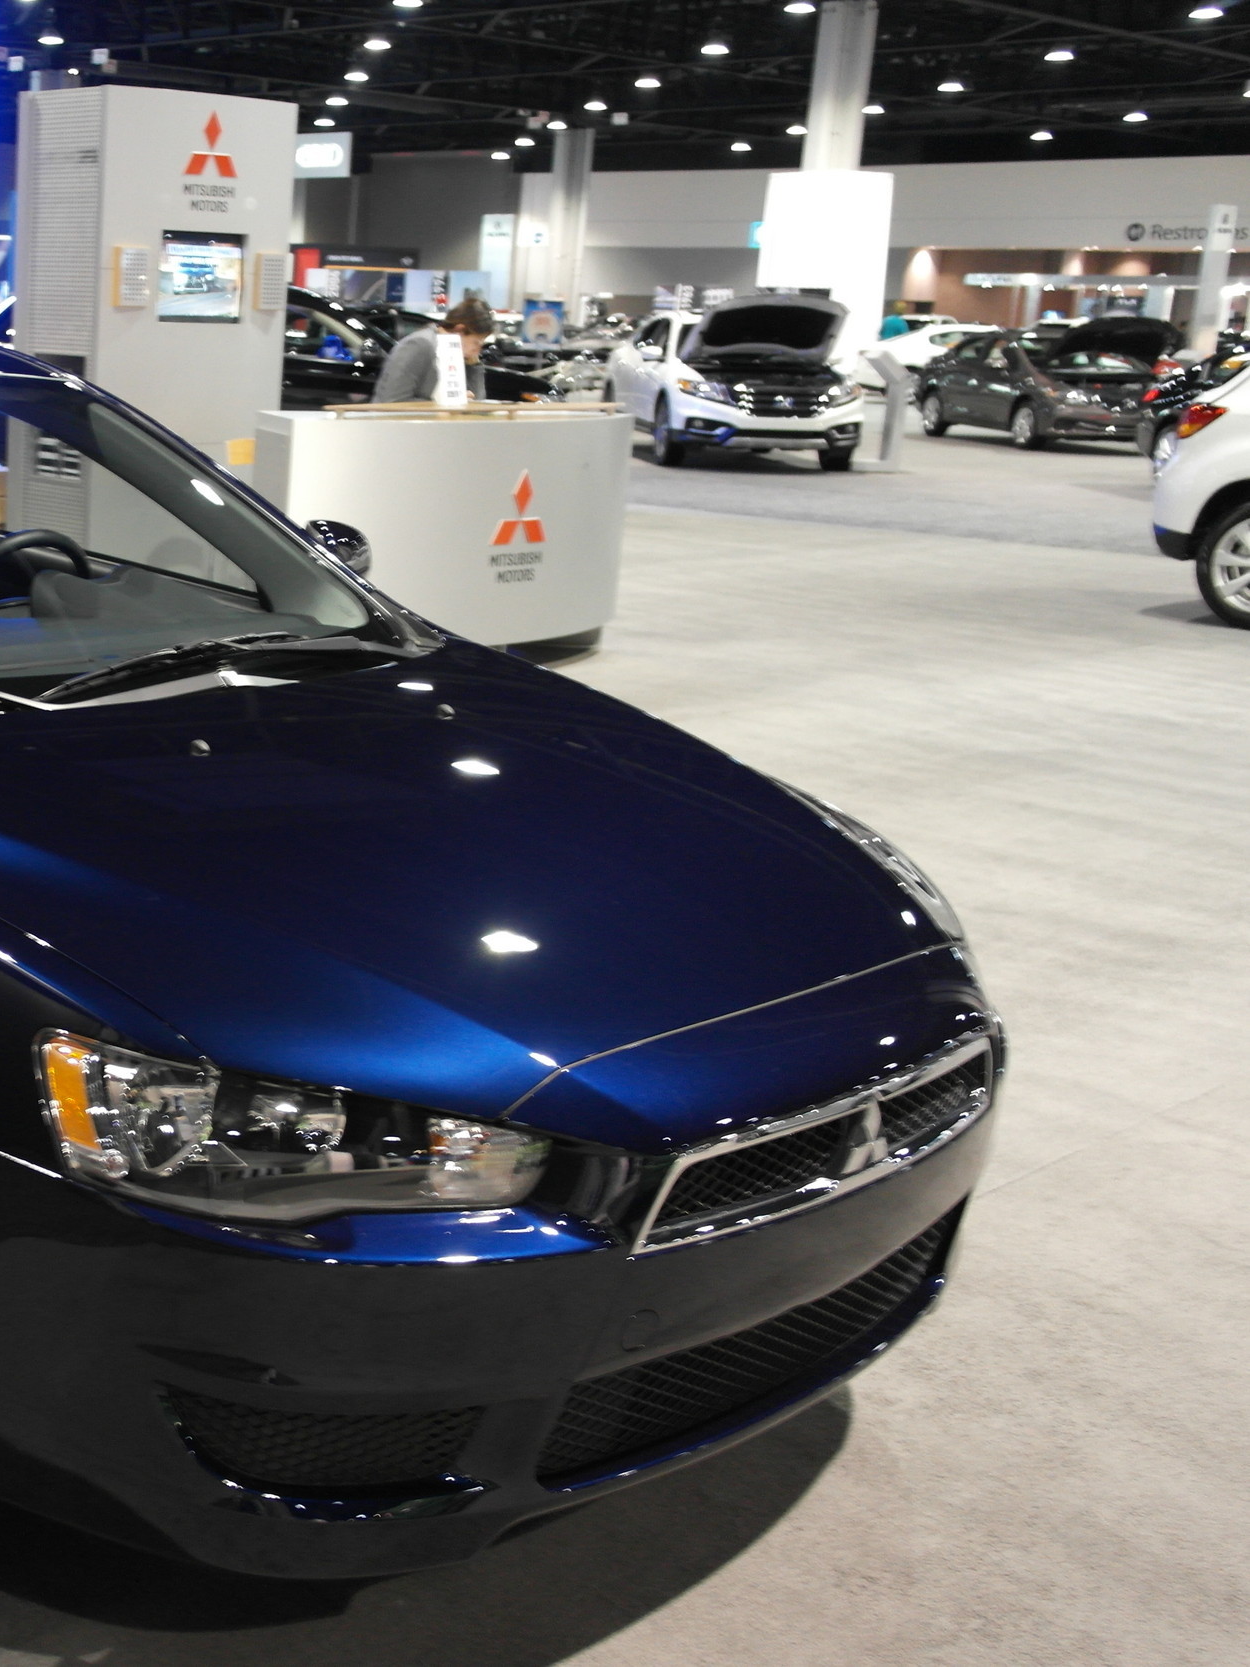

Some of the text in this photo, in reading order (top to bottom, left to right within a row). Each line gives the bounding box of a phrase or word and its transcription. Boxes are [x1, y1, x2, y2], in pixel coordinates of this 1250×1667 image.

[184, 184, 236, 198] MITSUBISHI
[191, 200, 229, 213] MOTORS
[1151, 224, 1249, 240] Restros
[490, 552, 542, 567] MITSUBISHI
[497, 568, 536, 583] MOTORS
